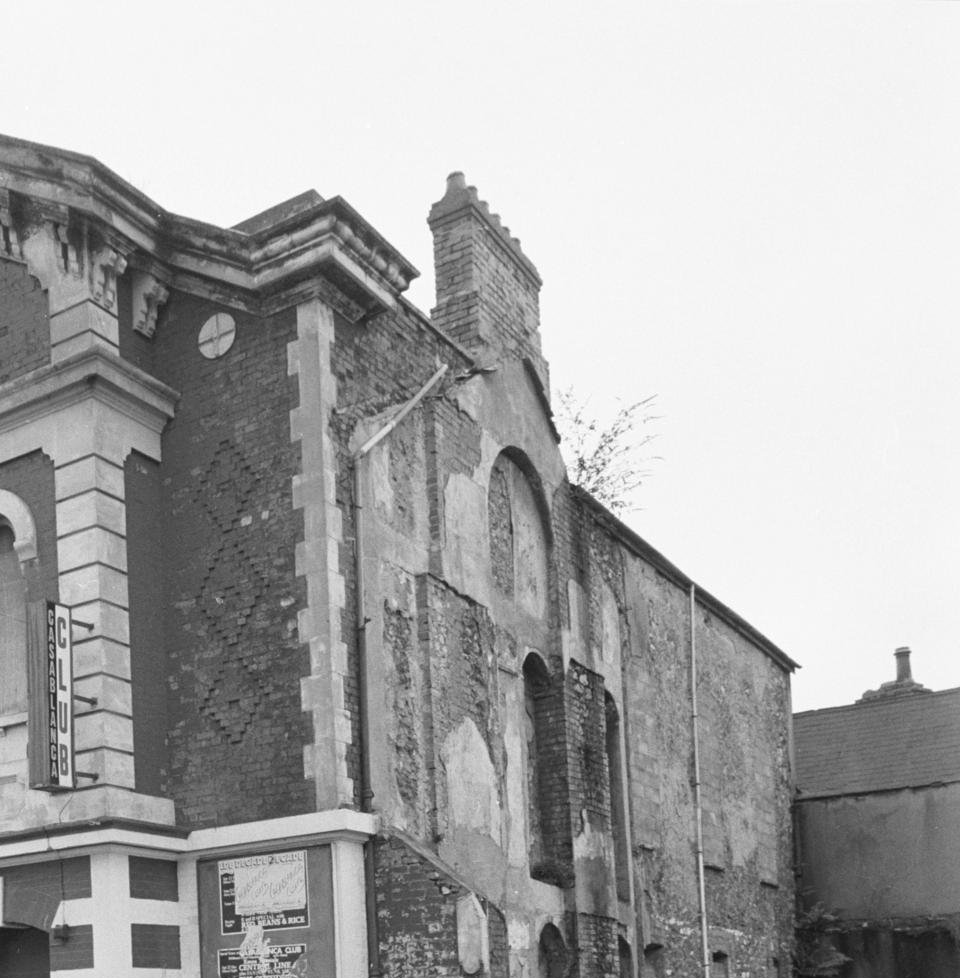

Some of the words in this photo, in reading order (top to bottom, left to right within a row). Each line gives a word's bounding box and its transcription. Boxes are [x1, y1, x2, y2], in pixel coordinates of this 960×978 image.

[48, 609, 58, 778] CASABLANCA
[57, 616, 69, 777] CLUB
[257, 918, 281, 927] BEANS
[288, 916, 305, 924] RICE
[284, 946, 302, 954] CLUB
[274, 961, 292, 969] LINE
